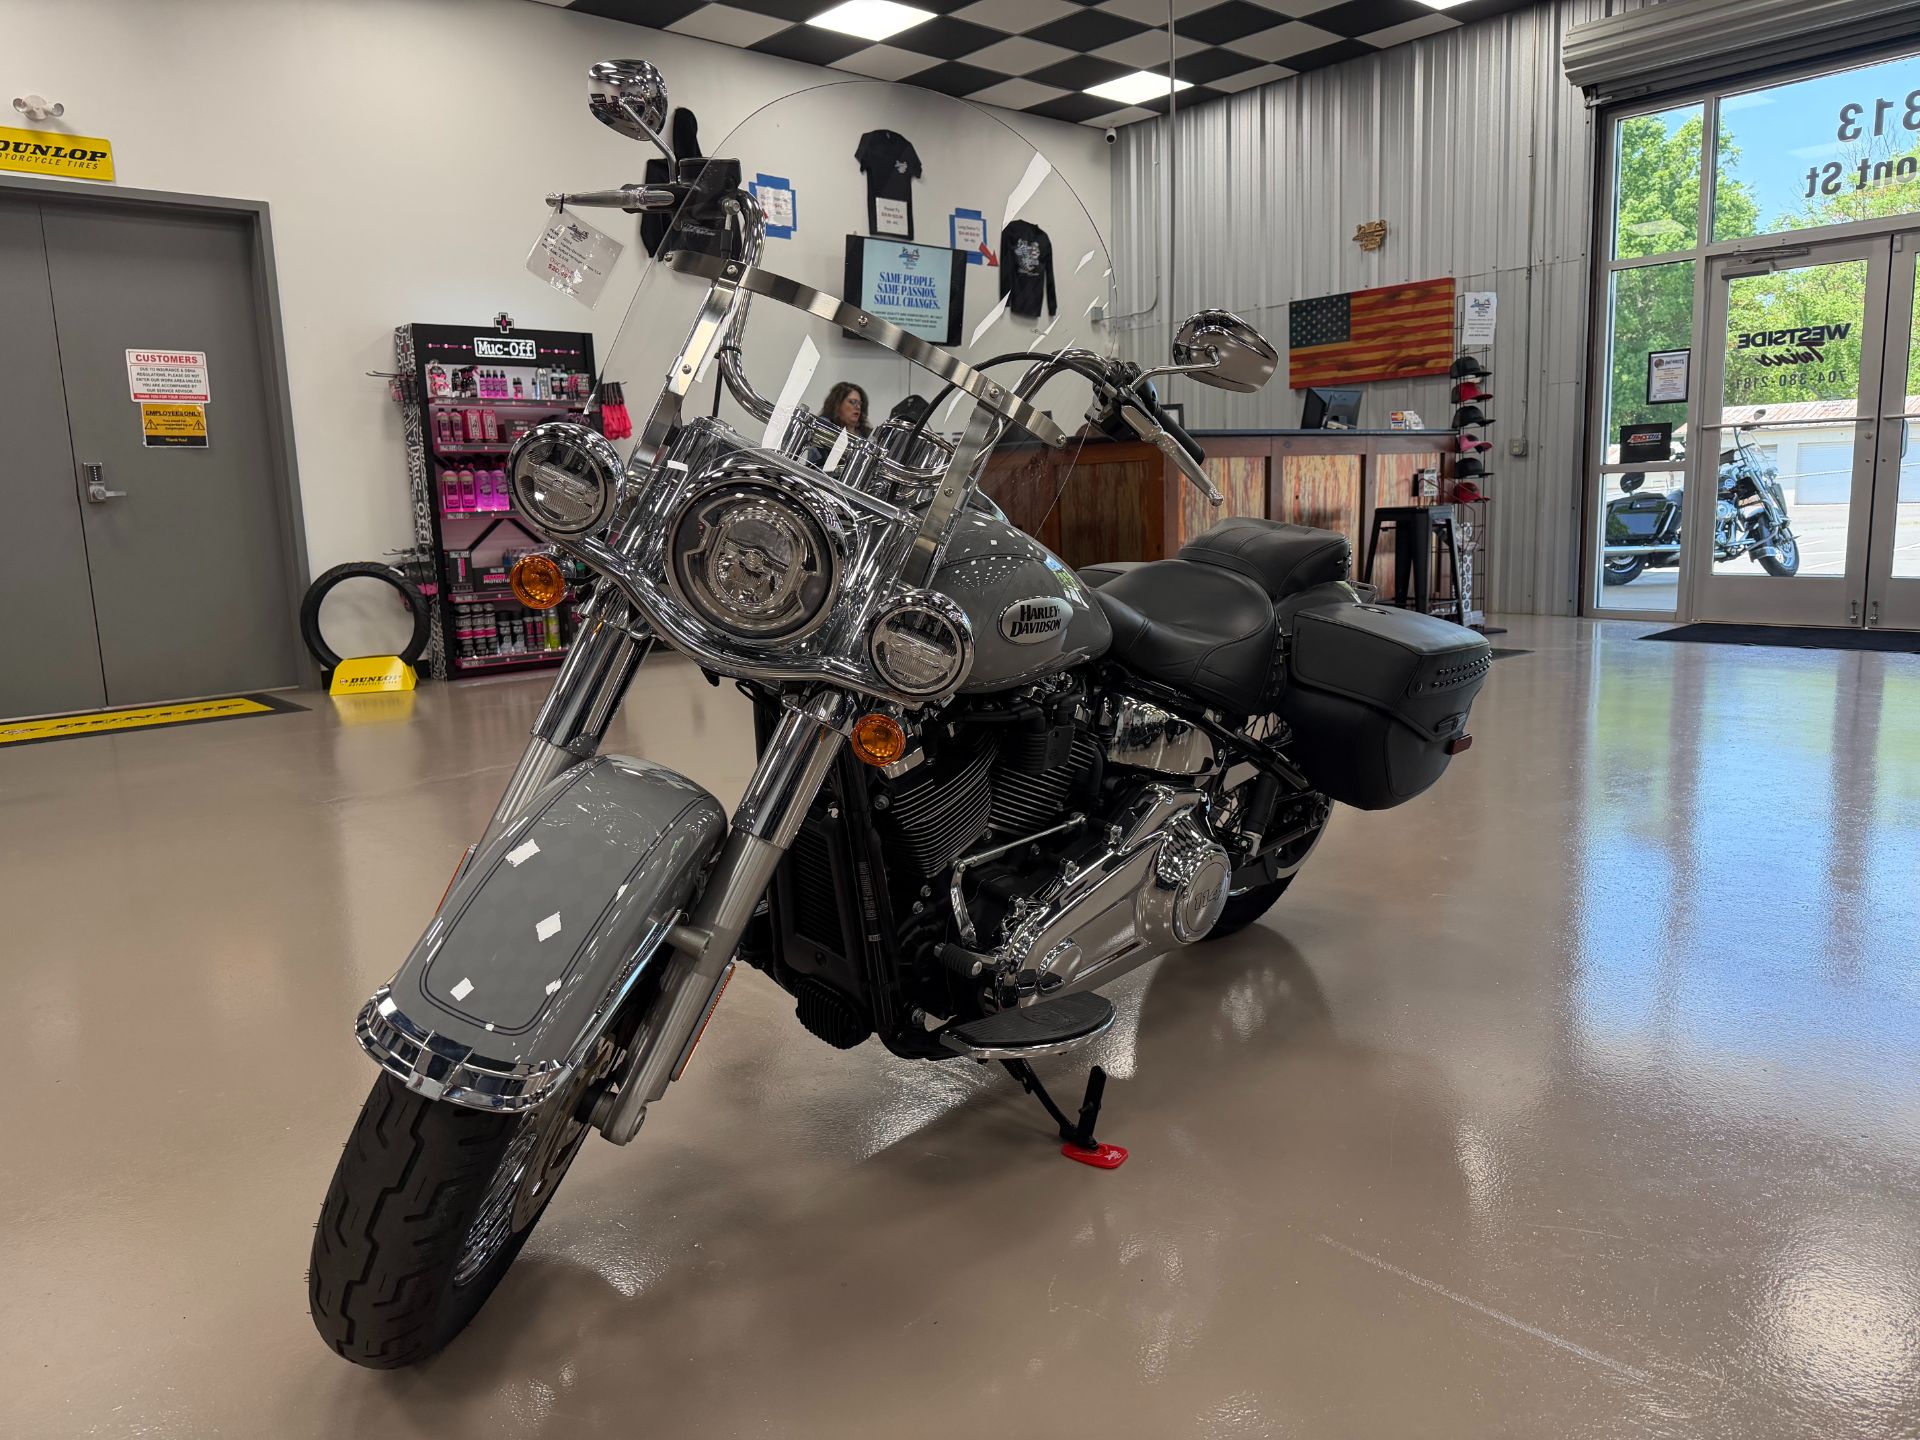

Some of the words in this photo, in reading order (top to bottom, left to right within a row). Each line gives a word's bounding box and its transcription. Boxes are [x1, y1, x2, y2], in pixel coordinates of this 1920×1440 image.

[0, 140, 108, 162] DUNLOP
[67, 160, 99, 170] TIRES
[549, 256, 560, 267] Our
[879, 271, 902, 284] SAME
[903, 274, 936, 288] PEOPLE.
[877, 283, 900, 296] SAME
[901, 285, 937, 299] PASSION.
[874, 294, 901, 307] SMALL
[902, 296, 941, 310] CHANGES.
[477, 340, 534, 357] Muc-Off
[135, 353, 199, 364] CUSTOMERS
[411, 450, 429, 538] Muc-Off
[1009, 619, 1062, 637] DAVIDSON
[350, 675, 401, 684] DUNLOP
